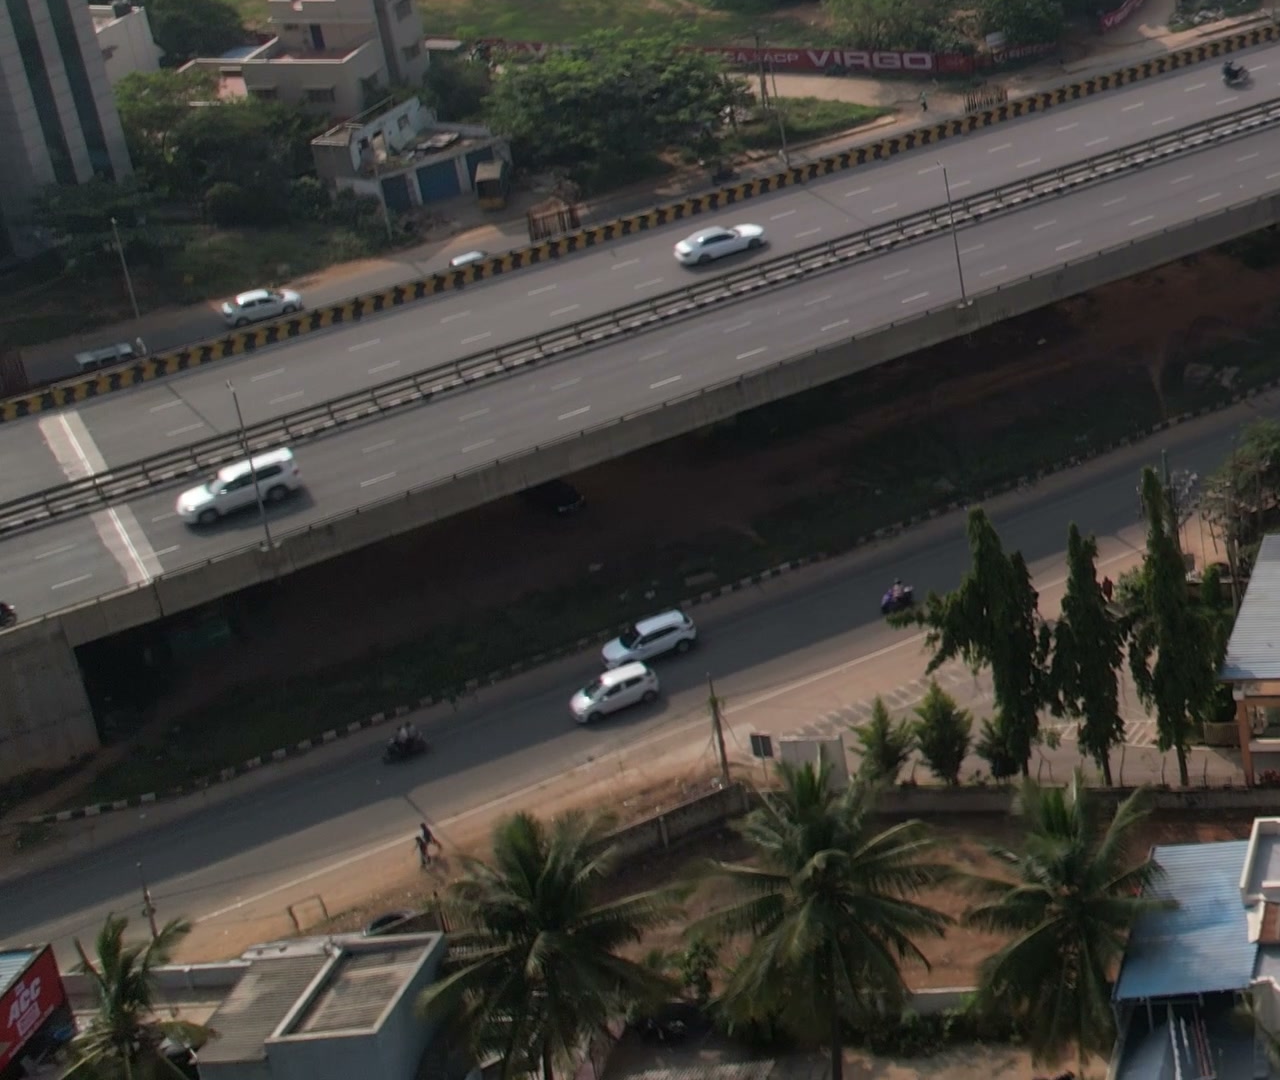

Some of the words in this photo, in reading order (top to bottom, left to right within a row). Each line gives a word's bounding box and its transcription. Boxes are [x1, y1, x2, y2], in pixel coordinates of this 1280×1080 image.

[764, 54, 799, 64] ACP
[806, 51, 932, 70] VIRGO
[7, 976, 41, 1029] ACC
